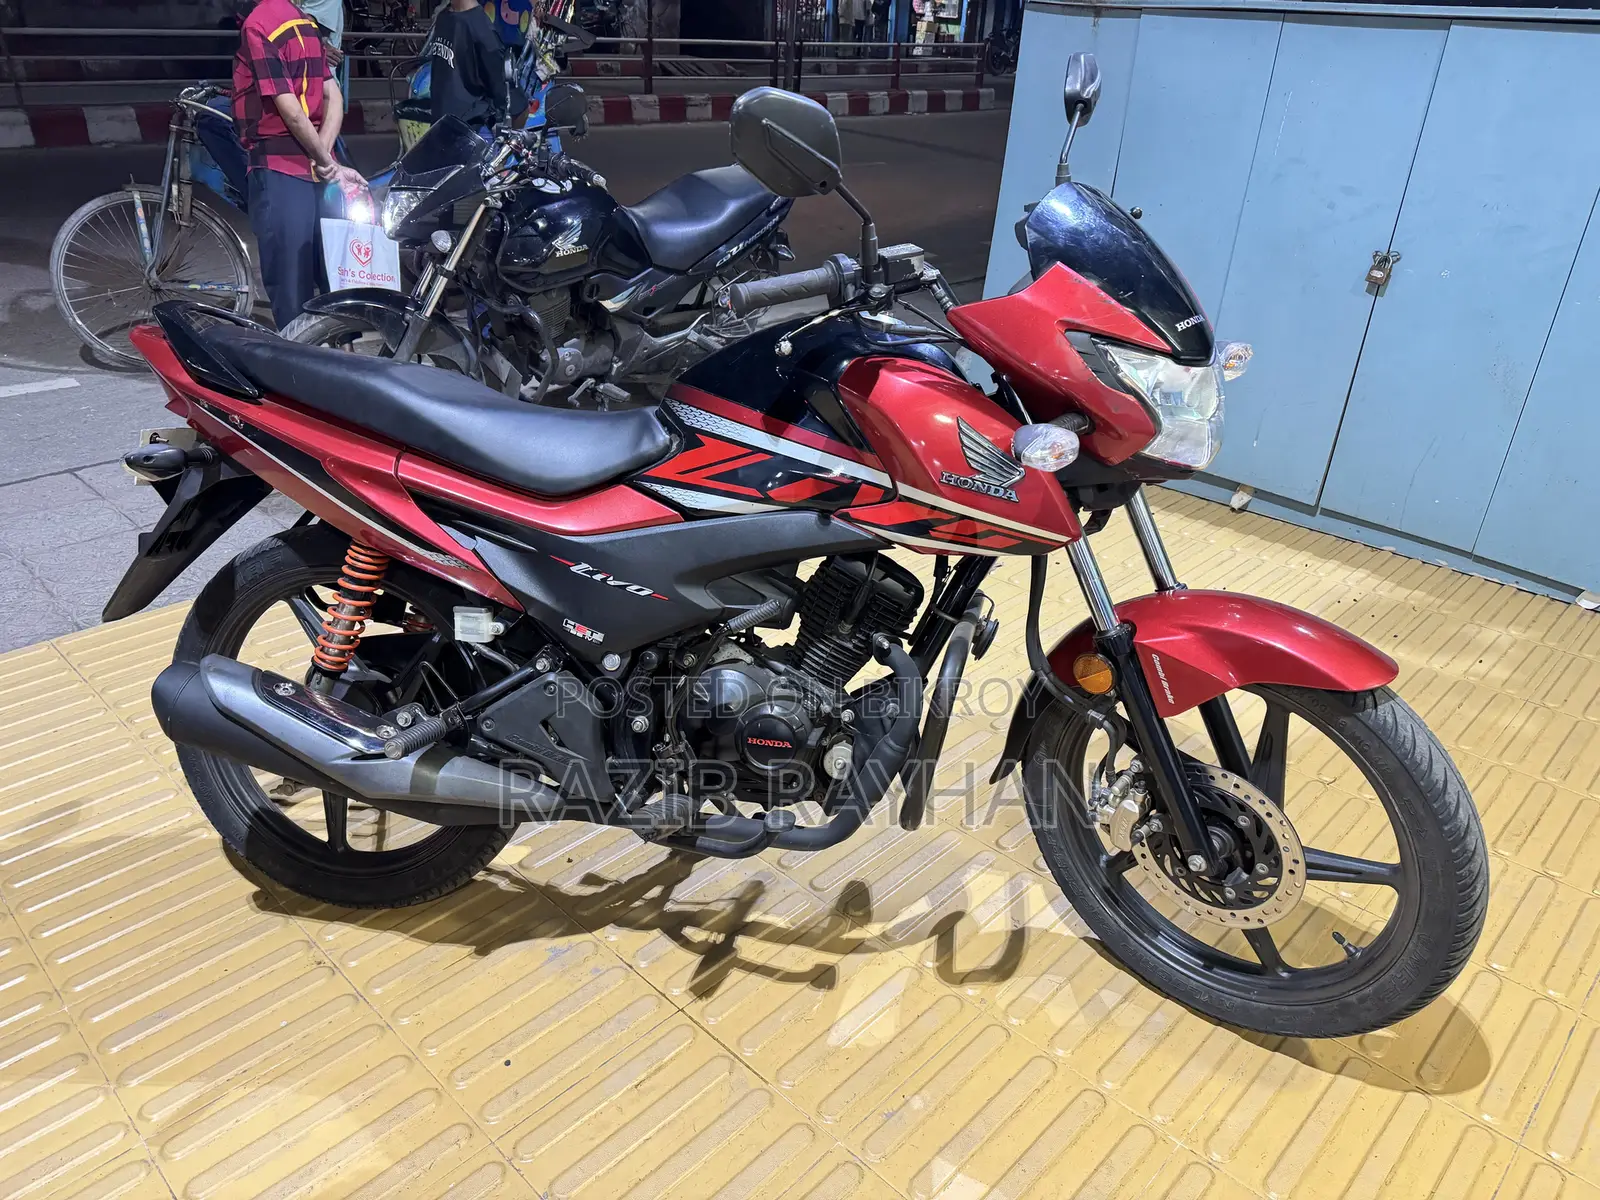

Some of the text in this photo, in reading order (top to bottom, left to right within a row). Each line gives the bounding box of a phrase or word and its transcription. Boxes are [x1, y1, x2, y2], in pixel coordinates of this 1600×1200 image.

[555, 244, 589, 258] HONDA
[1175, 314, 1206, 332] HONDA
[940, 471, 1020, 503] HONDA
[747, 736, 793, 748] HONDA
